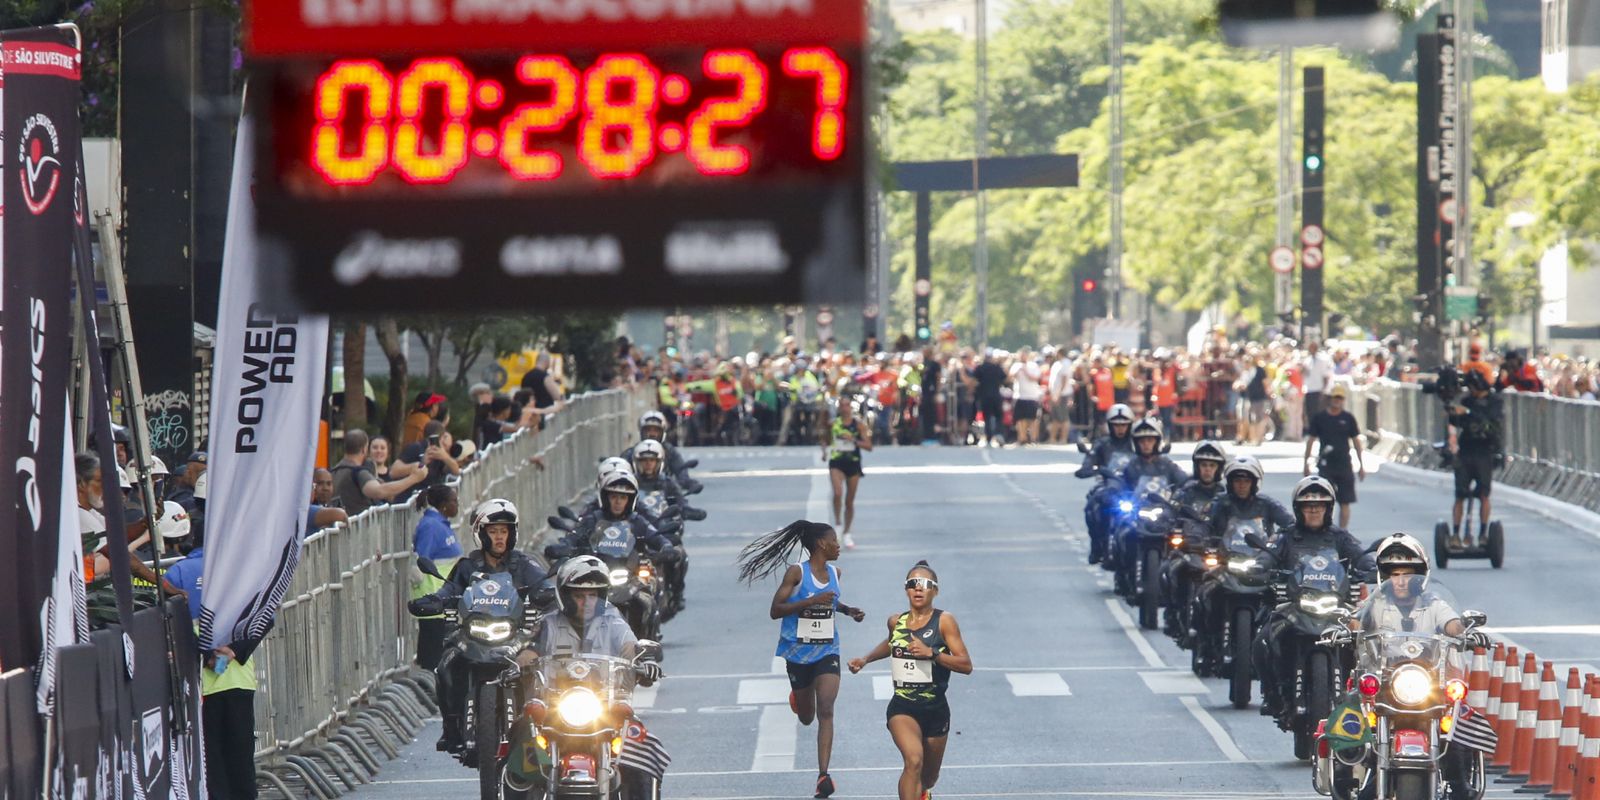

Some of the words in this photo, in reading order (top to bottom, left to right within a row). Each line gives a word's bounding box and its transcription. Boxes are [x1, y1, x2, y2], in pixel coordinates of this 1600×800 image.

[15, 47, 33, 64] SÃO
[34, 51, 74, 69] SILVESTRE
[312, 47, 848, 185] 00:28:27
[1303, 573, 1336, 581] POLÍCIA
[473, 597, 508, 606] POLÍCIA
[903, 662, 915, 670] 45
